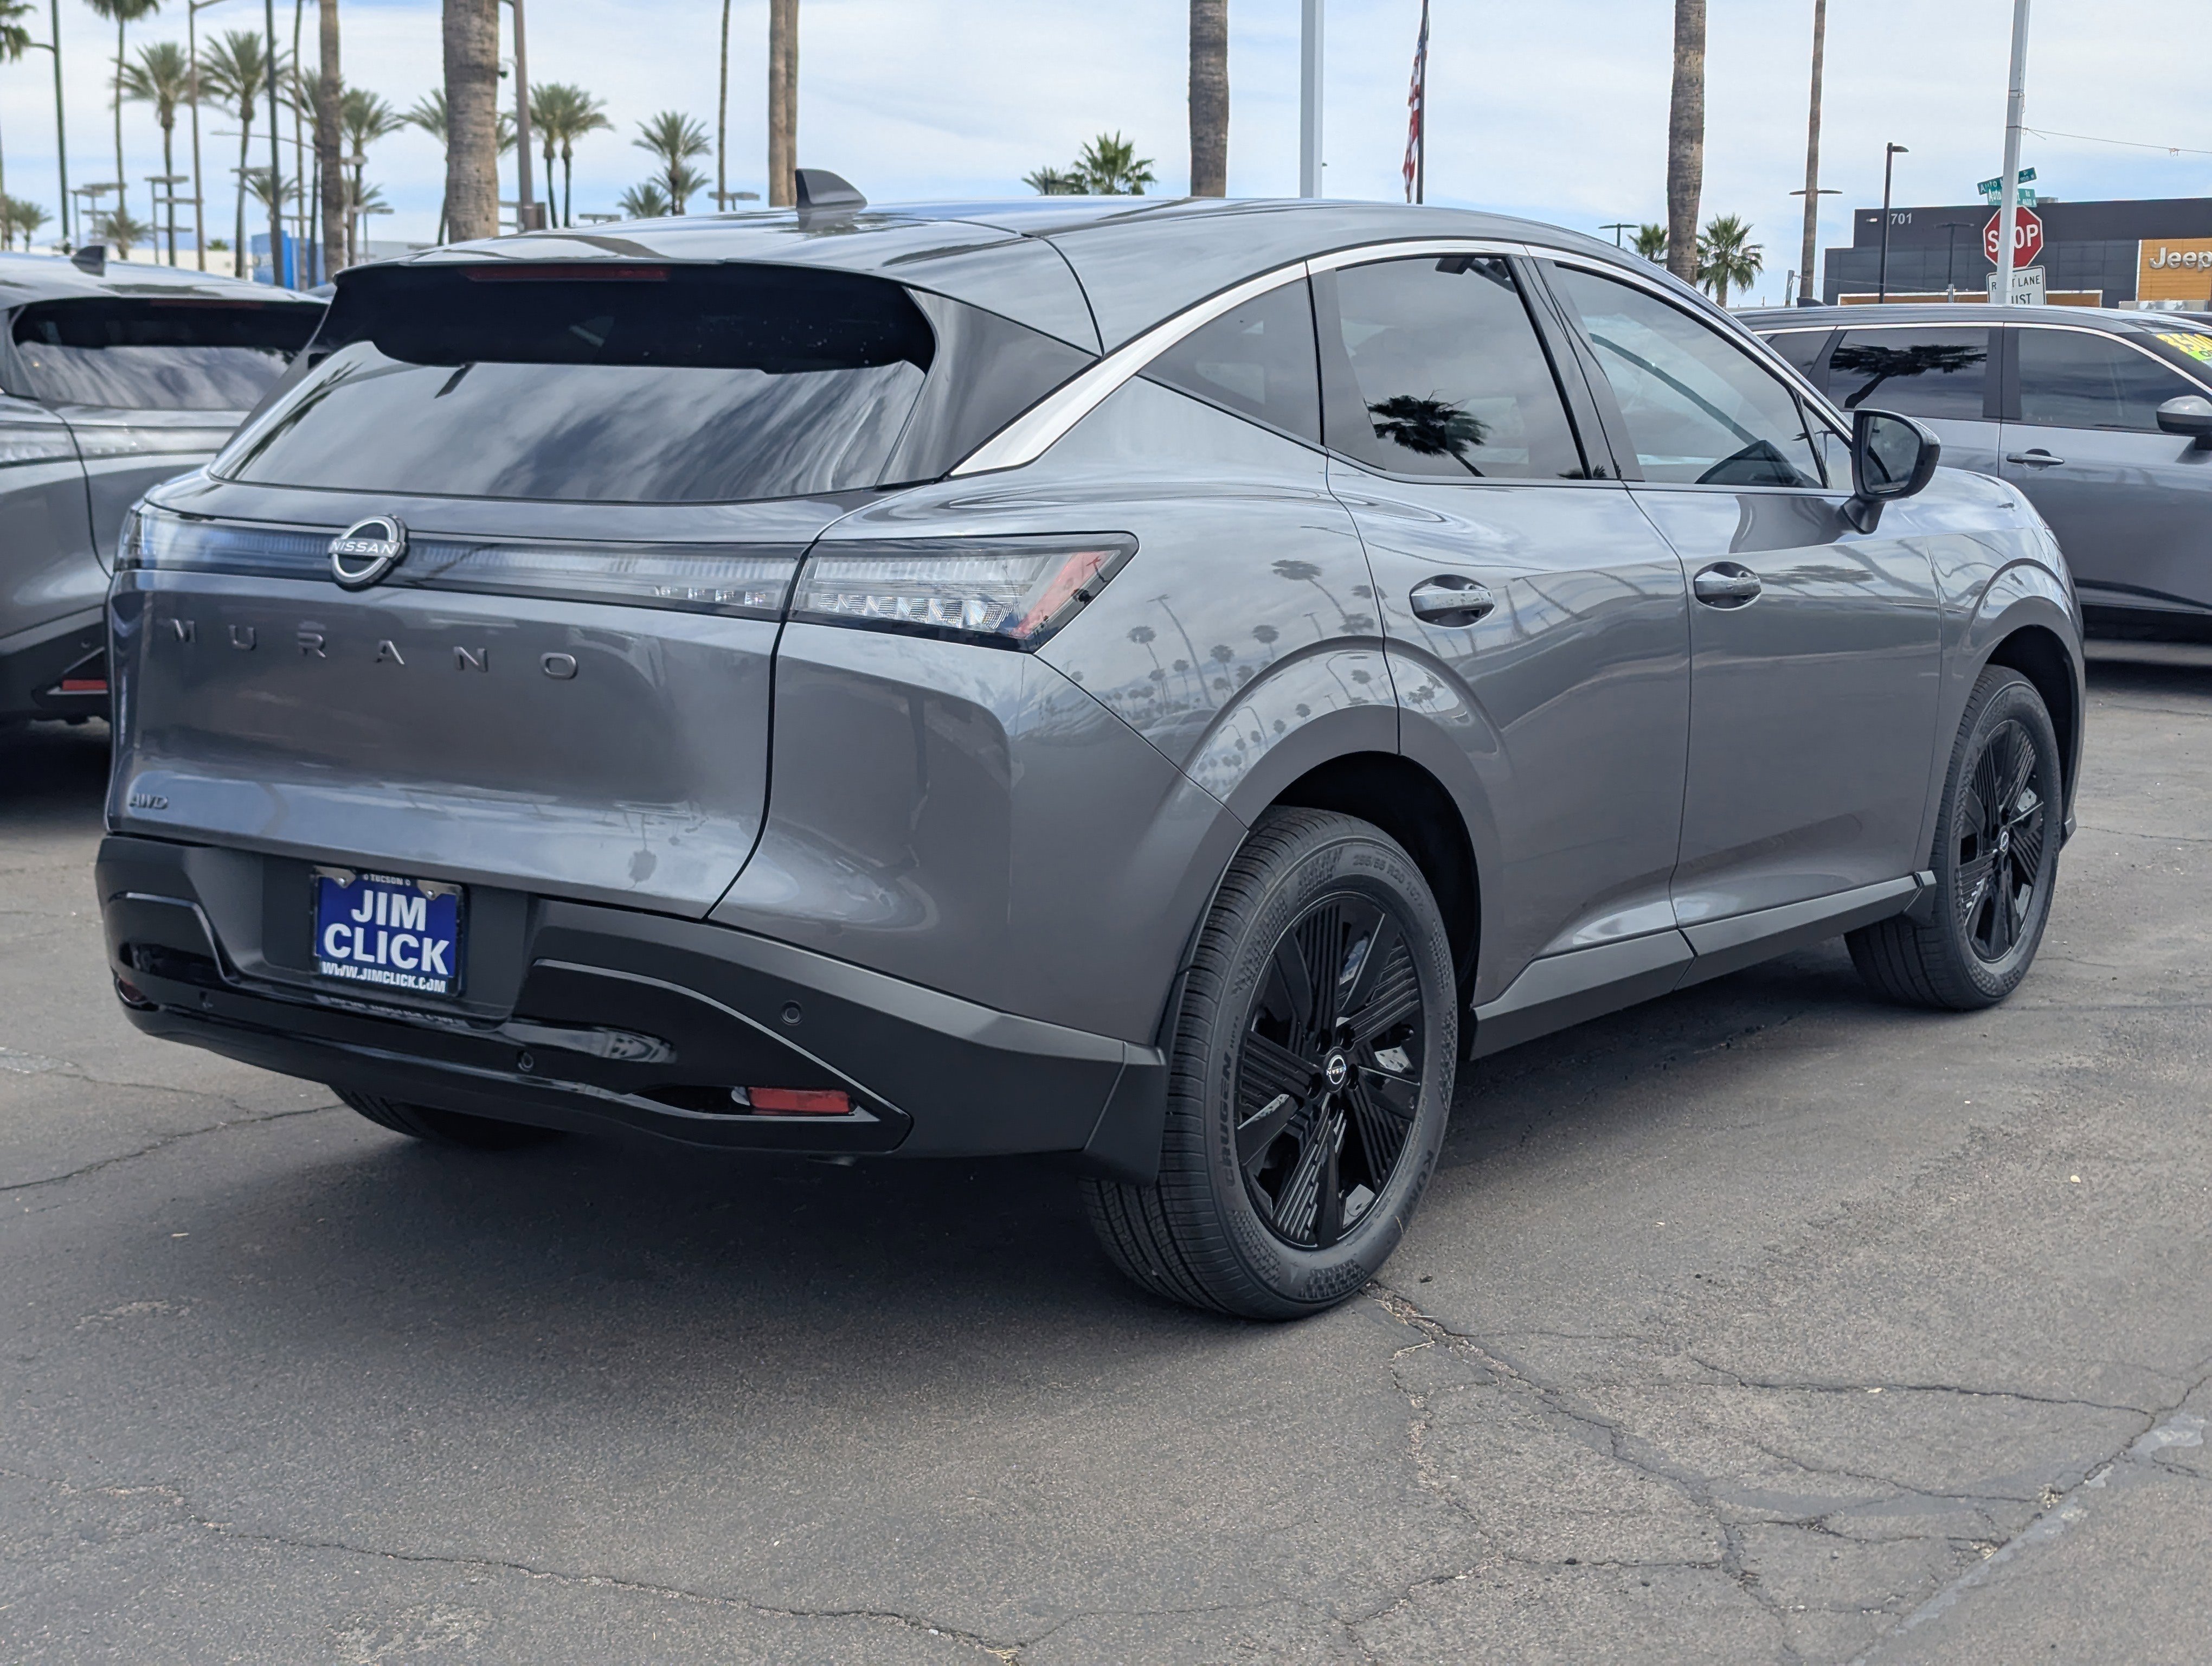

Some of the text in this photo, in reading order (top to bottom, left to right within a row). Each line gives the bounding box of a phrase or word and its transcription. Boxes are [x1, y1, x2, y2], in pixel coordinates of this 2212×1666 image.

[1980, 181, 1997, 193] Auto
[1989, 188, 2002, 202] Auto
[1891, 213, 1912, 225] 701
[1988, 225, 2039, 252] SOP
[2149, 247, 2212, 272] Jeep
[2018, 275, 2040, 287] LANE
[2011, 293, 2031, 304] UST
[331, 541, 396, 555] NISSAN
[170, 618, 578, 680] MURANO
[129, 793, 168, 810] AWD
[370, 875, 403, 885] TUCSON
[351, 889, 426, 932] JIM
[323, 922, 450, 975] CLICK
[320, 961, 446, 993] WWW.JIMCLICK.COM
[1220, 1051, 1235, 1187] CRUGEN
